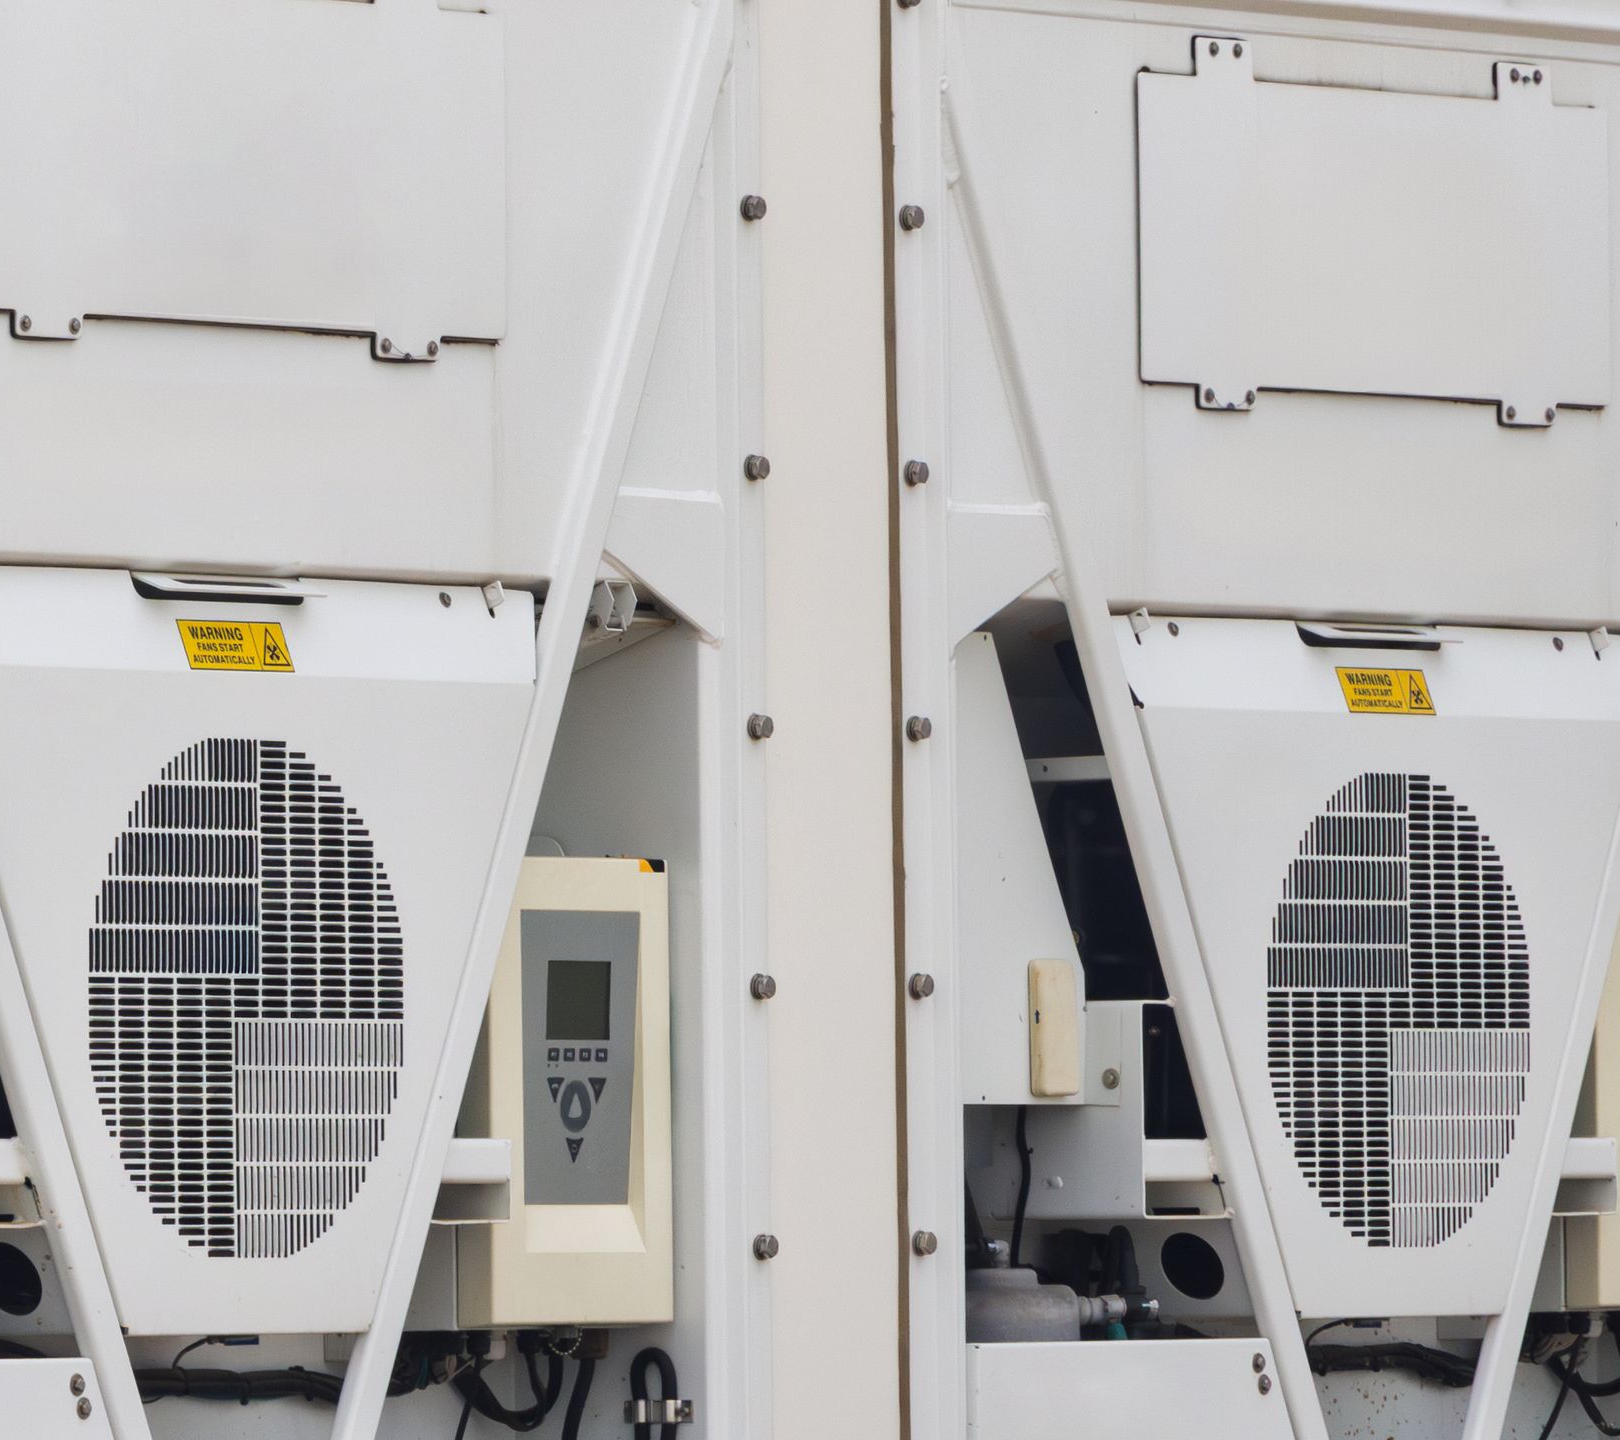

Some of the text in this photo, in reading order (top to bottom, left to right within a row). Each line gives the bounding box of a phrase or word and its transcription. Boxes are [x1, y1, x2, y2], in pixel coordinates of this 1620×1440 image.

[188, 626, 243, 641] WARNING
[197, 642, 243, 653] FANS START
[193, 654, 255, 665] AUTOMATICALLY
[1345, 672, 1393, 686] WARNING
